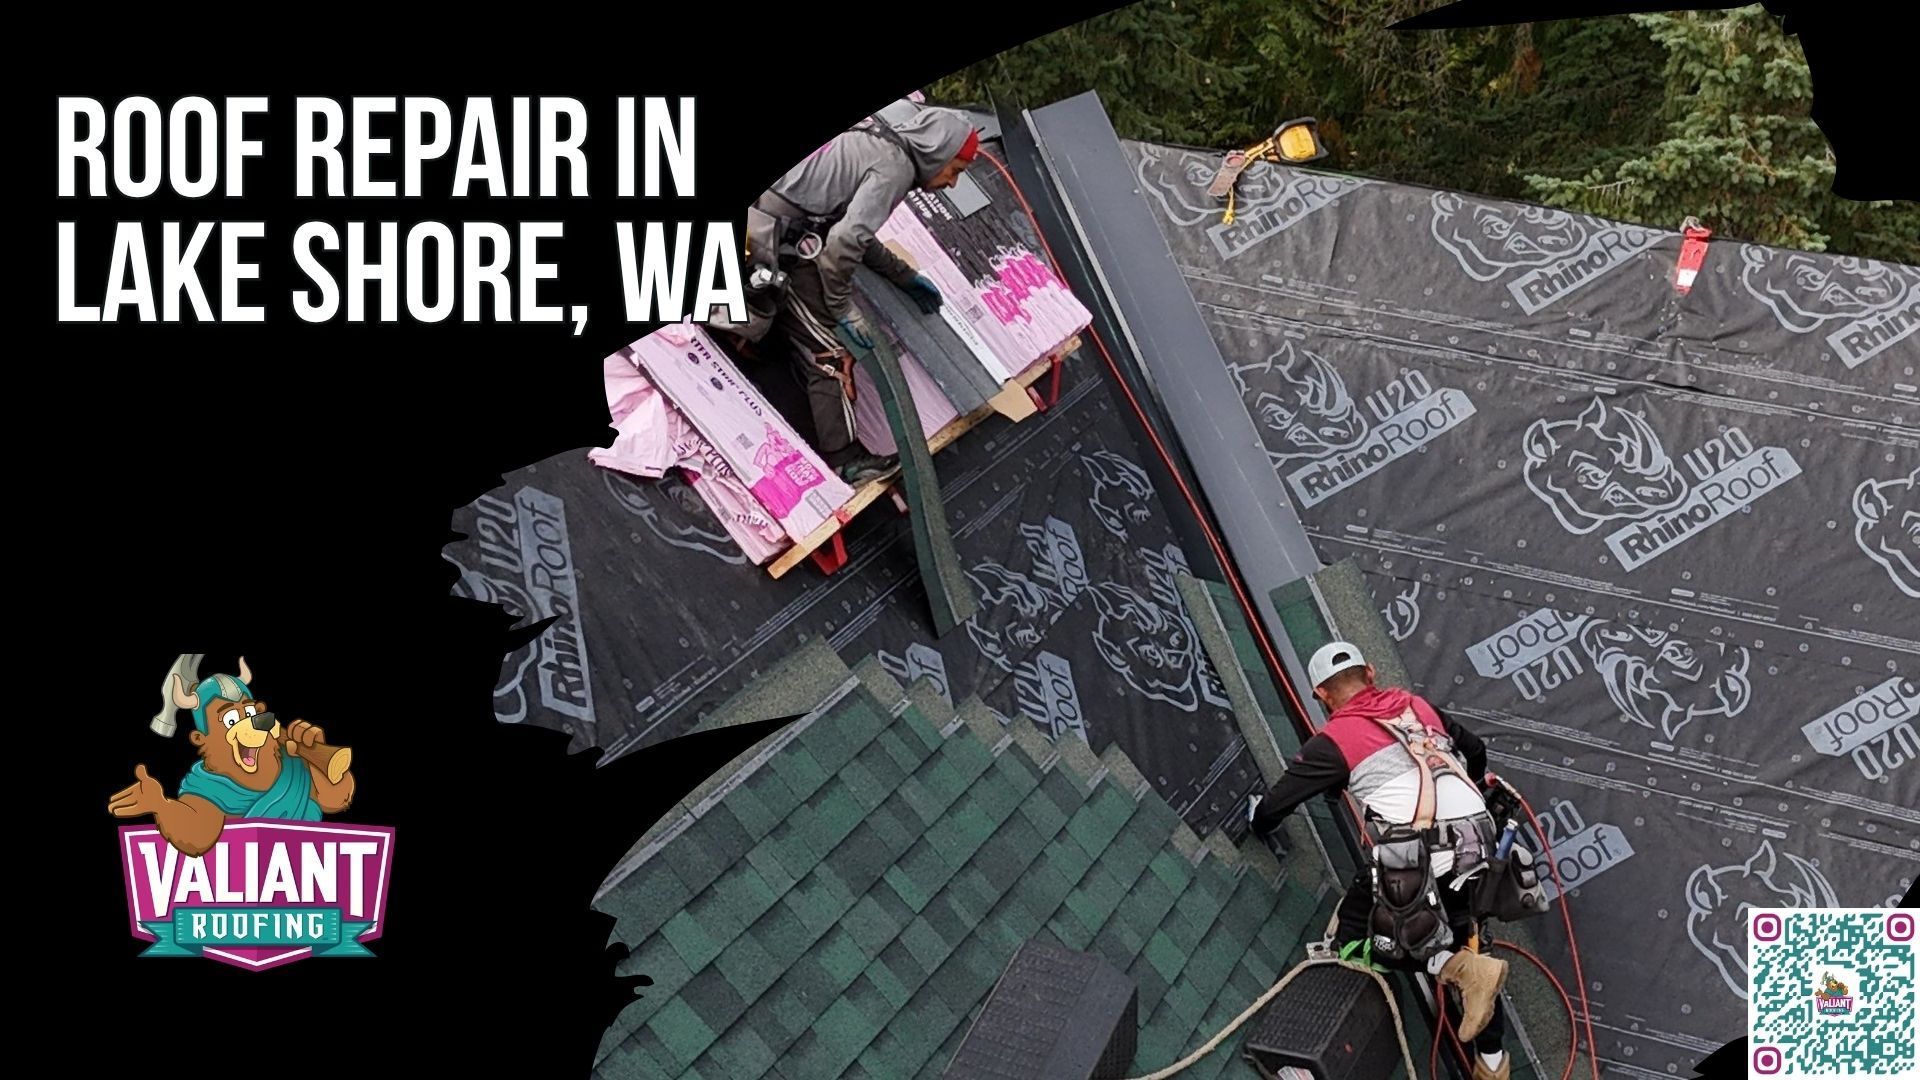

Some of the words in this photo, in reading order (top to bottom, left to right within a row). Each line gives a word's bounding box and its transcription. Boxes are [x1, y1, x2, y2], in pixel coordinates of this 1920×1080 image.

[1365, 369, 1432, 422] U20
[1300, 390, 1457, 499] RhinoRoof
[1683, 427, 1754, 481] U20
[1620, 450, 1783, 562] RhinoRoof
[1014, 661, 1050, 724] U20
[1512, 646, 1584, 700] U20
[1851, 722, 1920, 780] U20
